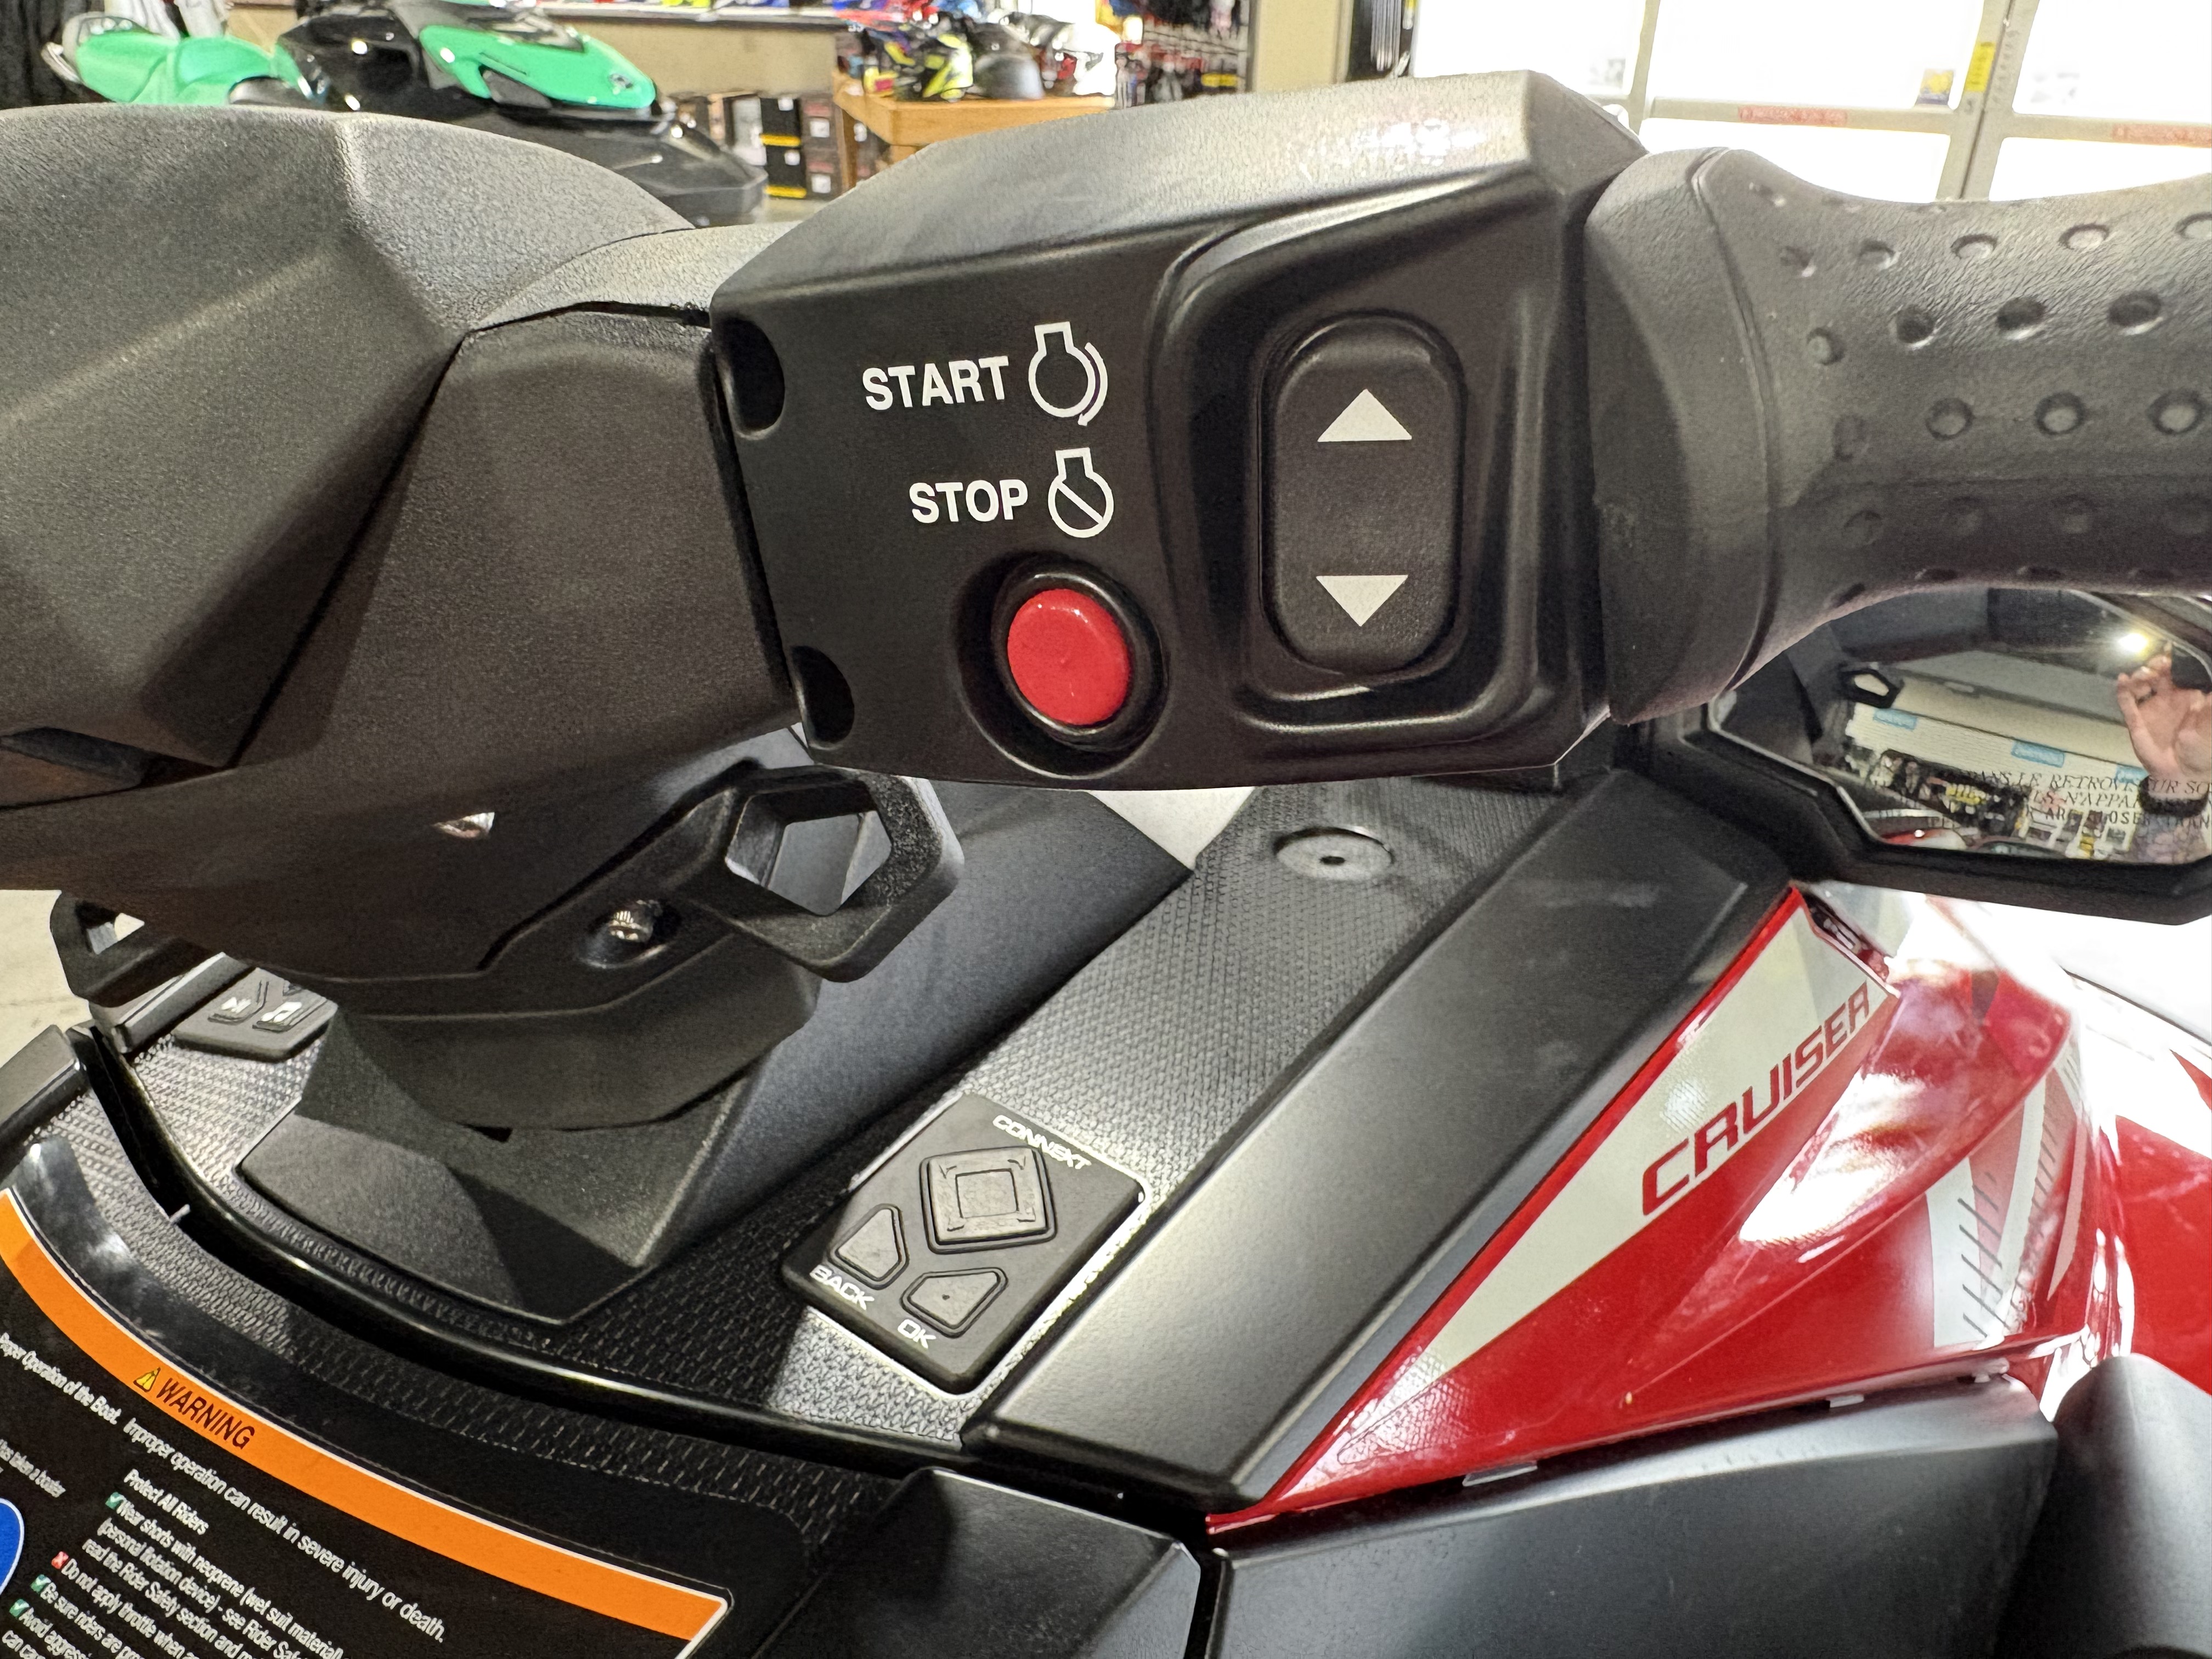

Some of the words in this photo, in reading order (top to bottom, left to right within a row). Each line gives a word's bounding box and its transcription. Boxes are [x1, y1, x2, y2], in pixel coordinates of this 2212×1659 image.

[862, 356, 1009, 411] START
[909, 479, 1028, 523] STOP
[1643, 981, 1870, 1215] CRUISER
[992, 1114, 1091, 1170] CONNEXT
[809, 1265, 874, 1311] BACK
[898, 1319, 936, 1349] OK
[156, 1378, 255, 1449] WARNING
[22, 1350, 67, 1389] Operation
[63, 1380, 82, 1395] of
[74, 1385, 94, 1407] the
[90, 1395, 122, 1425] Boat.
[123, 1418, 175, 1459] Improper
[171, 1452, 227, 1494] operation
[224, 1487, 251, 1510] can
[247, 1502, 288, 1534] result
[283, 1522, 300, 1544] in
[297, 1536, 345, 1573] severe
[342, 1561, 385, 1601] injury
[382, 1592, 403, 1610] or
[399, 1602, 445, 1643] death.
[123, 1469, 164, 1503] Protect
[157, 1493, 179, 1513] All
[172, 1502, 209, 1535] Riders
[82, 1539, 110, 1562] read
[103, 1551, 123, 1573] the
[119, 1562, 149, 1591] Rider
[145, 1582, 180, 1618] Safety
[176, 1607, 218, 1643] section
[215, 1635, 244, 1658] and
[97, 1517, 147, 1556] (personal
[179, 1576, 221, 1613] device)
[222, 1609, 246, 1630] see
[242, 1619, 277, 1651] Rider
[116, 1499, 145, 1526] Wear
[140, 1519, 174, 1548] shorts
[171, 1539, 196, 1564] with
[193, 1555, 245, 1597] neoprene
[240, 1587, 271, 1615] (wet
[266, 1607, 293, 1632] suit
[2, 1630, 24, 1652] can
[19, 1607, 54, 1638] Avoid
[40, 1582, 59, 1604] Be
[54, 1595, 79, 1619] sure
[74, 1610, 106, 1641] riders
[101, 1633, 123, 1654] are
[61, 1559, 80, 1580] Do
[75, 1572, 99, 1593] not
[92, 1585, 123, 1614] apply
[118, 1602, 156, 1638] throttle
[154, 1630, 185, 1659] when
